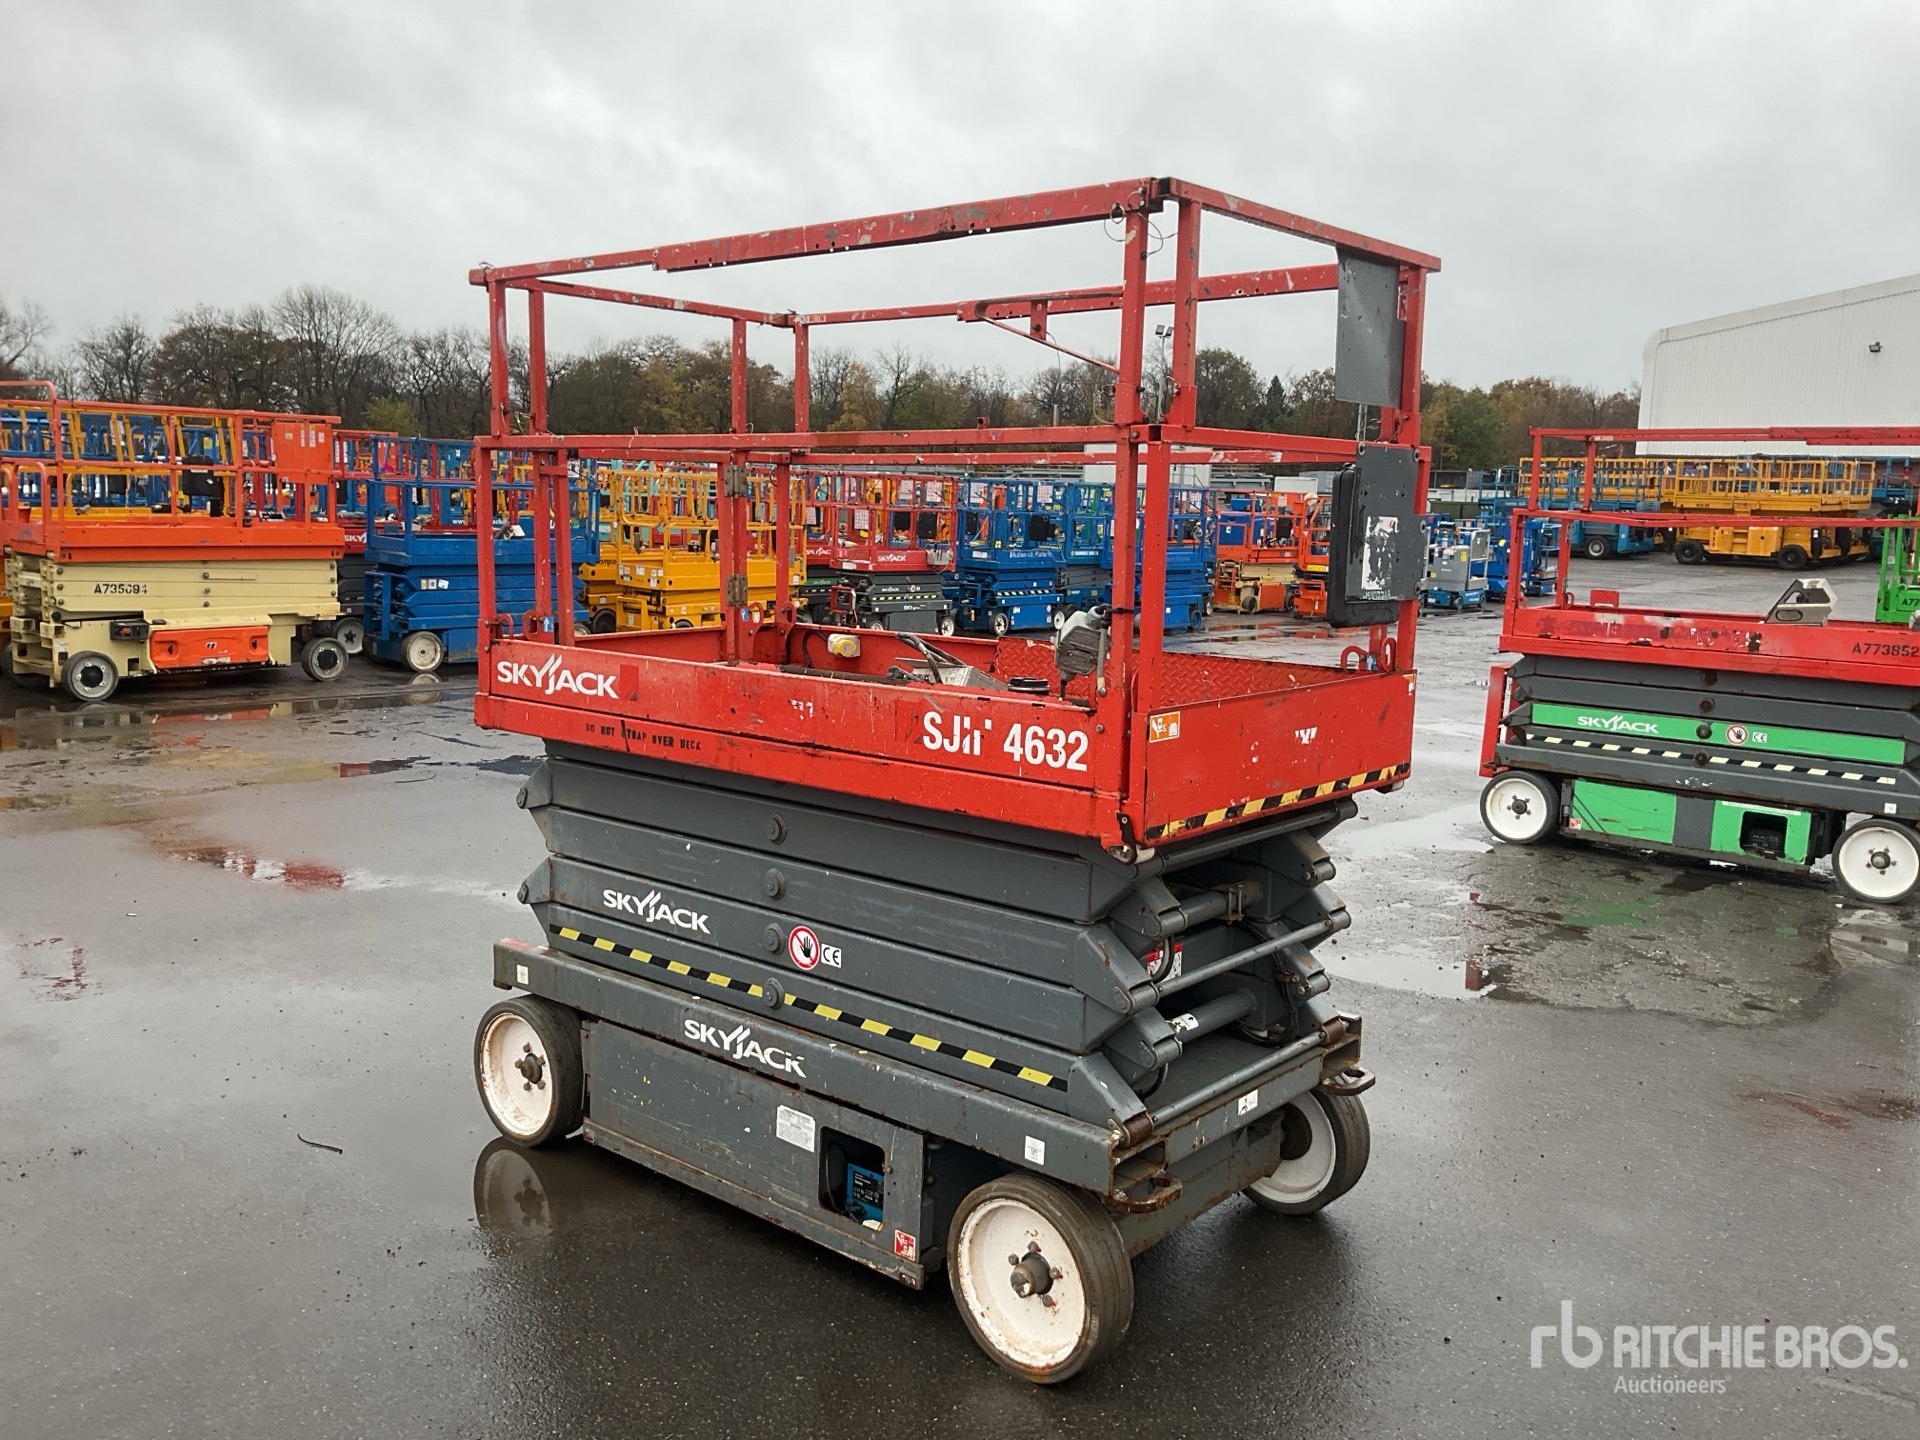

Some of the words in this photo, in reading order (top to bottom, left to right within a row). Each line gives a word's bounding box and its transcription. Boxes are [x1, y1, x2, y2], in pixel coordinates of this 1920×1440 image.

[878, 554, 906, 562] SKYJACK
[1852, 642, 1920, 657] A773852
[497, 653, 619, 699] SKYJACK
[600, 725, 615, 737] NOT
[651, 735, 674, 747] OVER
[1577, 714, 1658, 734] SKYJACK
[1003, 723, 1089, 772] 4632
[602, 889, 711, 934] SKYJACK
[684, 1019, 807, 1078] SKYJACK
